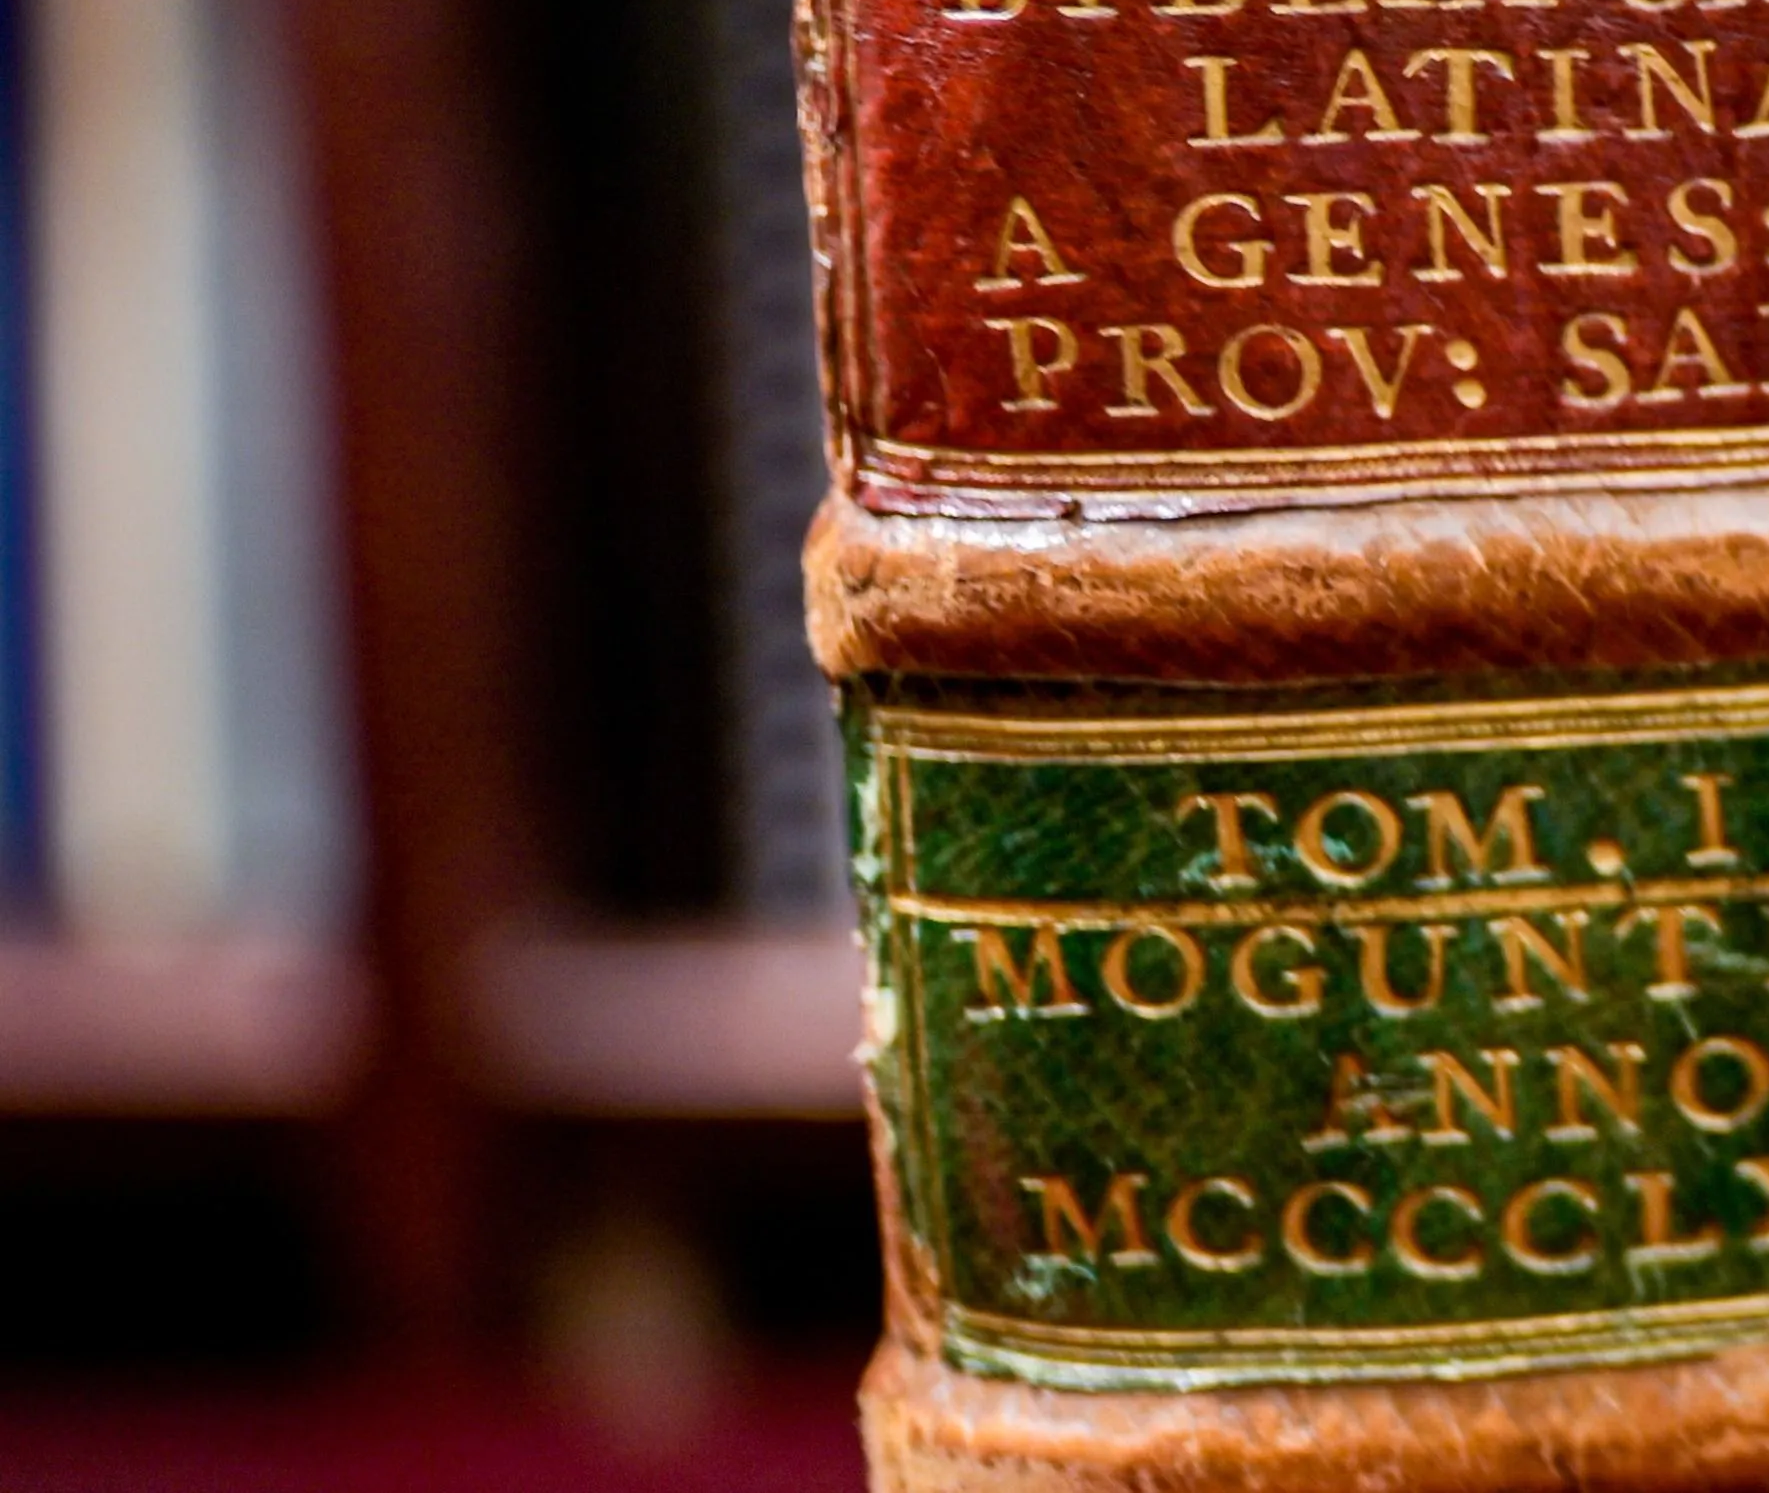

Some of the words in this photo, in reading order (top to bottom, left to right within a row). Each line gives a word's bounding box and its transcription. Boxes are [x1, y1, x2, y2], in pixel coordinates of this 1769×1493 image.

[973, 195, 1087, 294] A
[983, 318, 1489, 423] PROV:
[1178, 784, 1624, 891] TOM.
